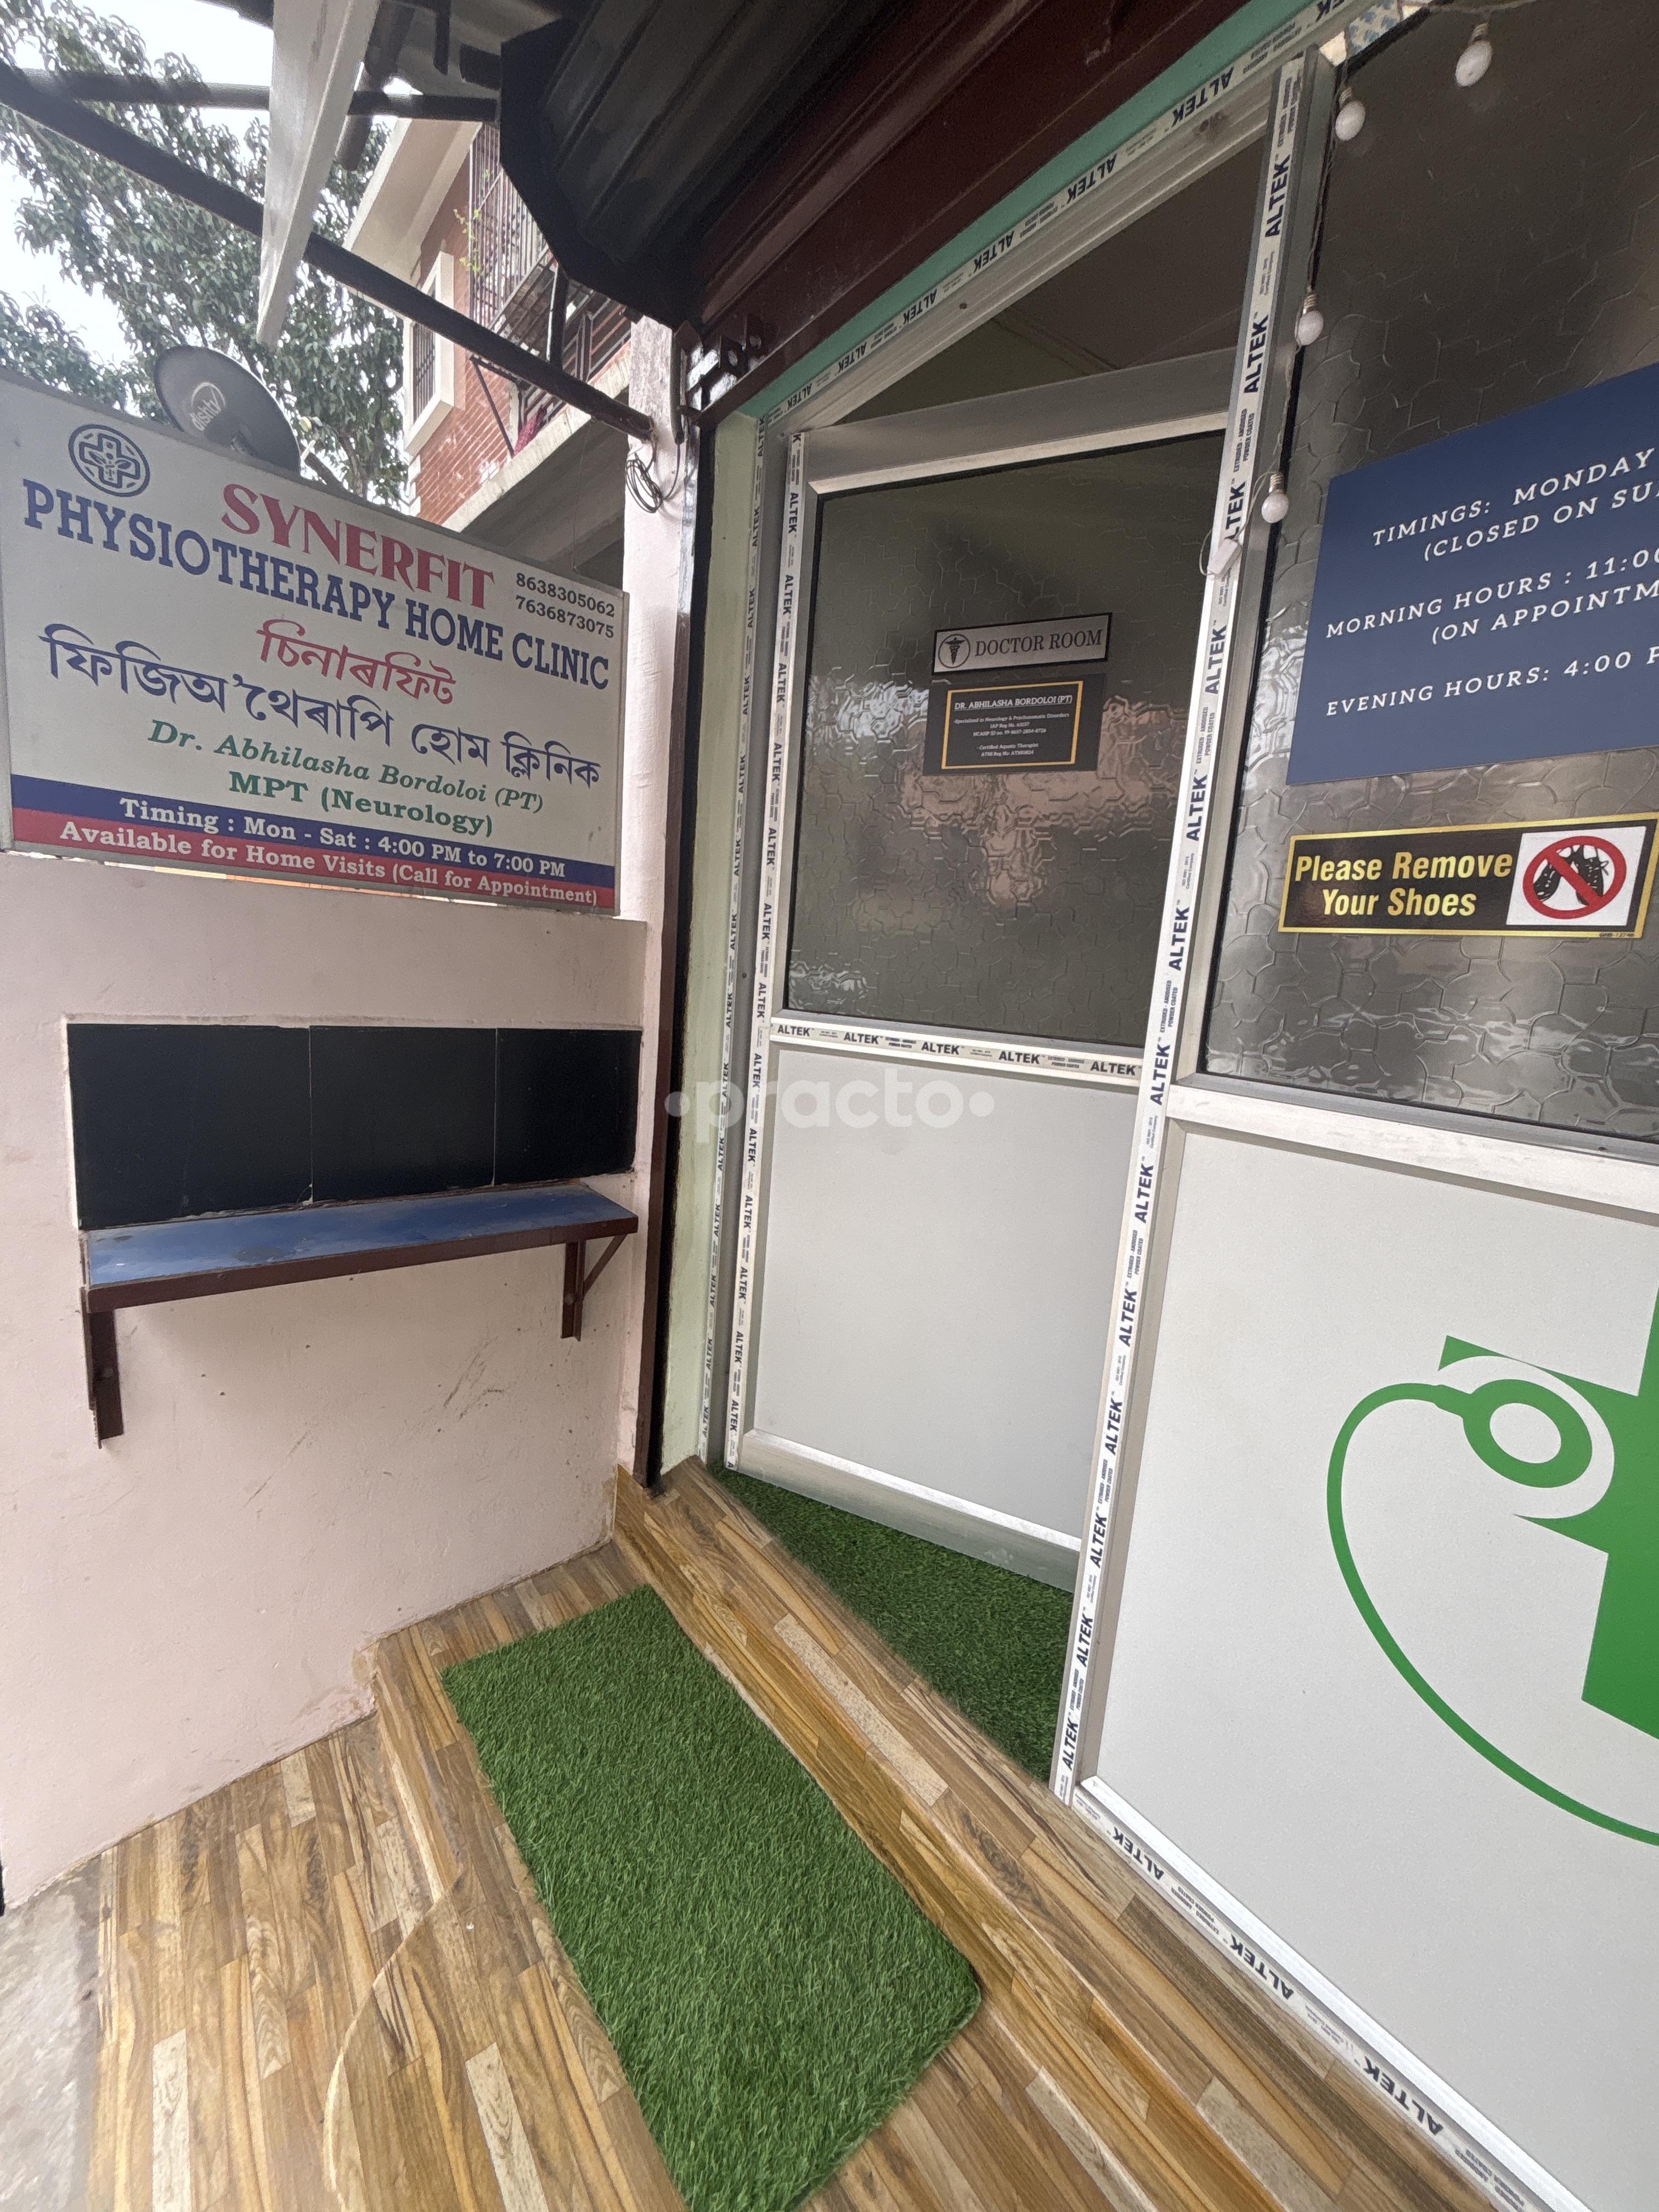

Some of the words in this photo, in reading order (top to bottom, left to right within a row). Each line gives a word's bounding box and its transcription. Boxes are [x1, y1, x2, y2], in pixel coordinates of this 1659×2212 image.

[1171, 66, 1234, 127] ALTEK
[1066, 154, 1117, 205] ALTEK
[1265, 154, 1291, 238] ALTEK
[973, 230, 1014, 273] ALTEK
[1244, 314, 1269, 394] ALTEK
[788, 492, 799, 534] ALTEK
[1224, 481, 1246, 540] LTEK
[1373, 500, 1491, 546] TIMINGS:
[1512, 447, 1656, 506] MONDAY
[1424, 514, 1539, 561] (CLOSED
[1552, 496, 1599, 524] ON
[1611, 481, 1659, 509] SU
[221, 483, 495, 610] SYNERFIT
[23, 478, 396, 629] PHYSIOTHERAPY
[406, 599, 503, 661] HOME
[512, 633, 609, 690] CLINIC
[516, 573, 615, 617] 8638305062
[782, 574, 794, 616] ALTEK
[1325, 599, 1443, 639] MORNING
[1453, 571, 1552, 610] HOURS
[516, 595, 614, 639] 7636873075
[975, 635, 1045, 657] DOCTOR
[1049, 629, 1104, 650] ROOM
[1431, 618, 1480, 645] (ON
[256, 618, 456, 704] চিনাৰফিট
[776, 662, 787, 703] ALTEK
[1205, 625, 1227, 695] ALTEK
[1326, 685, 1434, 716] EVENING
[1443, 667, 1549, 698] HOURS:
[1562, 651, 1633, 678] 4:00
[968, 698, 1013, 709] ABHILASHA
[1015, 696, 1057, 706] BORDOLOI
[1057, 695, 1073, 704] (PT)
[148, 720, 203, 751] Dr.
[213, 734, 370, 781] Abhilasha
[378, 764, 487, 803] Bordoloi
[495, 787, 543, 814] (PT)
[412, 724, 490, 765] হোম
[500, 731, 601, 788] ক্লিনিক
[772, 742, 782, 782] ALTEK
[229, 771, 308, 803] MPT
[321, 786, 493, 837] (Neurology)
[1186, 774, 1207, 842] ALTEK
[60, 821, 191, 856] Available
[202, 842, 237, 860] for
[246, 845, 315, 869] Home
[323, 854, 385, 878] Visits
[392, 864, 438, 885] (Call
[444, 870, 471, 889] for
[477, 879, 597, 907] Appointment)
[120, 797, 219, 834] Timing
[244, 816, 296, 841] Mon
[320, 828, 357, 849] Sat
[378, 836, 425, 857] 4:00
[431, 844, 461, 863] PM
[468, 849, 488, 867] to
[494, 853, 534, 873] 7:00
[539, 860, 566, 877] PM
[766, 827, 776, 866] ALTEK
[1295, 855, 1382, 882] Please
[1392, 851, 1513, 879] Remove
[761, 902, 772, 940] ALTEK
[1322, 889, 1379, 916] Your
[1388, 888, 1477, 916] Shoes
[1169, 906, 1190, 971] ALTEK
[757, 981, 767, 1019] ALTEK
[777, 1024, 810, 1037] ALTEK
[843, 1032, 879, 1045] ALTEK
[921, 1042, 960, 1055] ALTEK
[998, 1051, 1040, 1065] ALTEK
[752, 1053, 762, 1089] ALTEK
[1090, 1060, 1138, 1076] ALTEK
[1150, 1045, 1171, 1106] ALTEK
[747, 1128, 758, 1163] ALTEK
[743, 1195, 753, 1229] ALTEK
[1135, 1164, 1154, 1224] ALTEK
[738, 1266, 748, 1300] ALTEK
[1119, 1287, 1137, 1347] ALTEK
[735, 1330, 744, 1364] ALTEK
[730, 1400, 740, 1433] ALTEK
[1104, 1397, 1123, 1456] ALTEK
[1090, 1510, 1108, 1569] ALTEK
[1076, 1613, 1093, 1668] ALTEK
[1062, 1715, 1079, 1771] ALTEK
[1113, 1826, 1164, 1881] ALTEK
[1229, 1933, 1295, 2000] ALTEK
[1363, 2056, 1444, 2135] ALTEK
